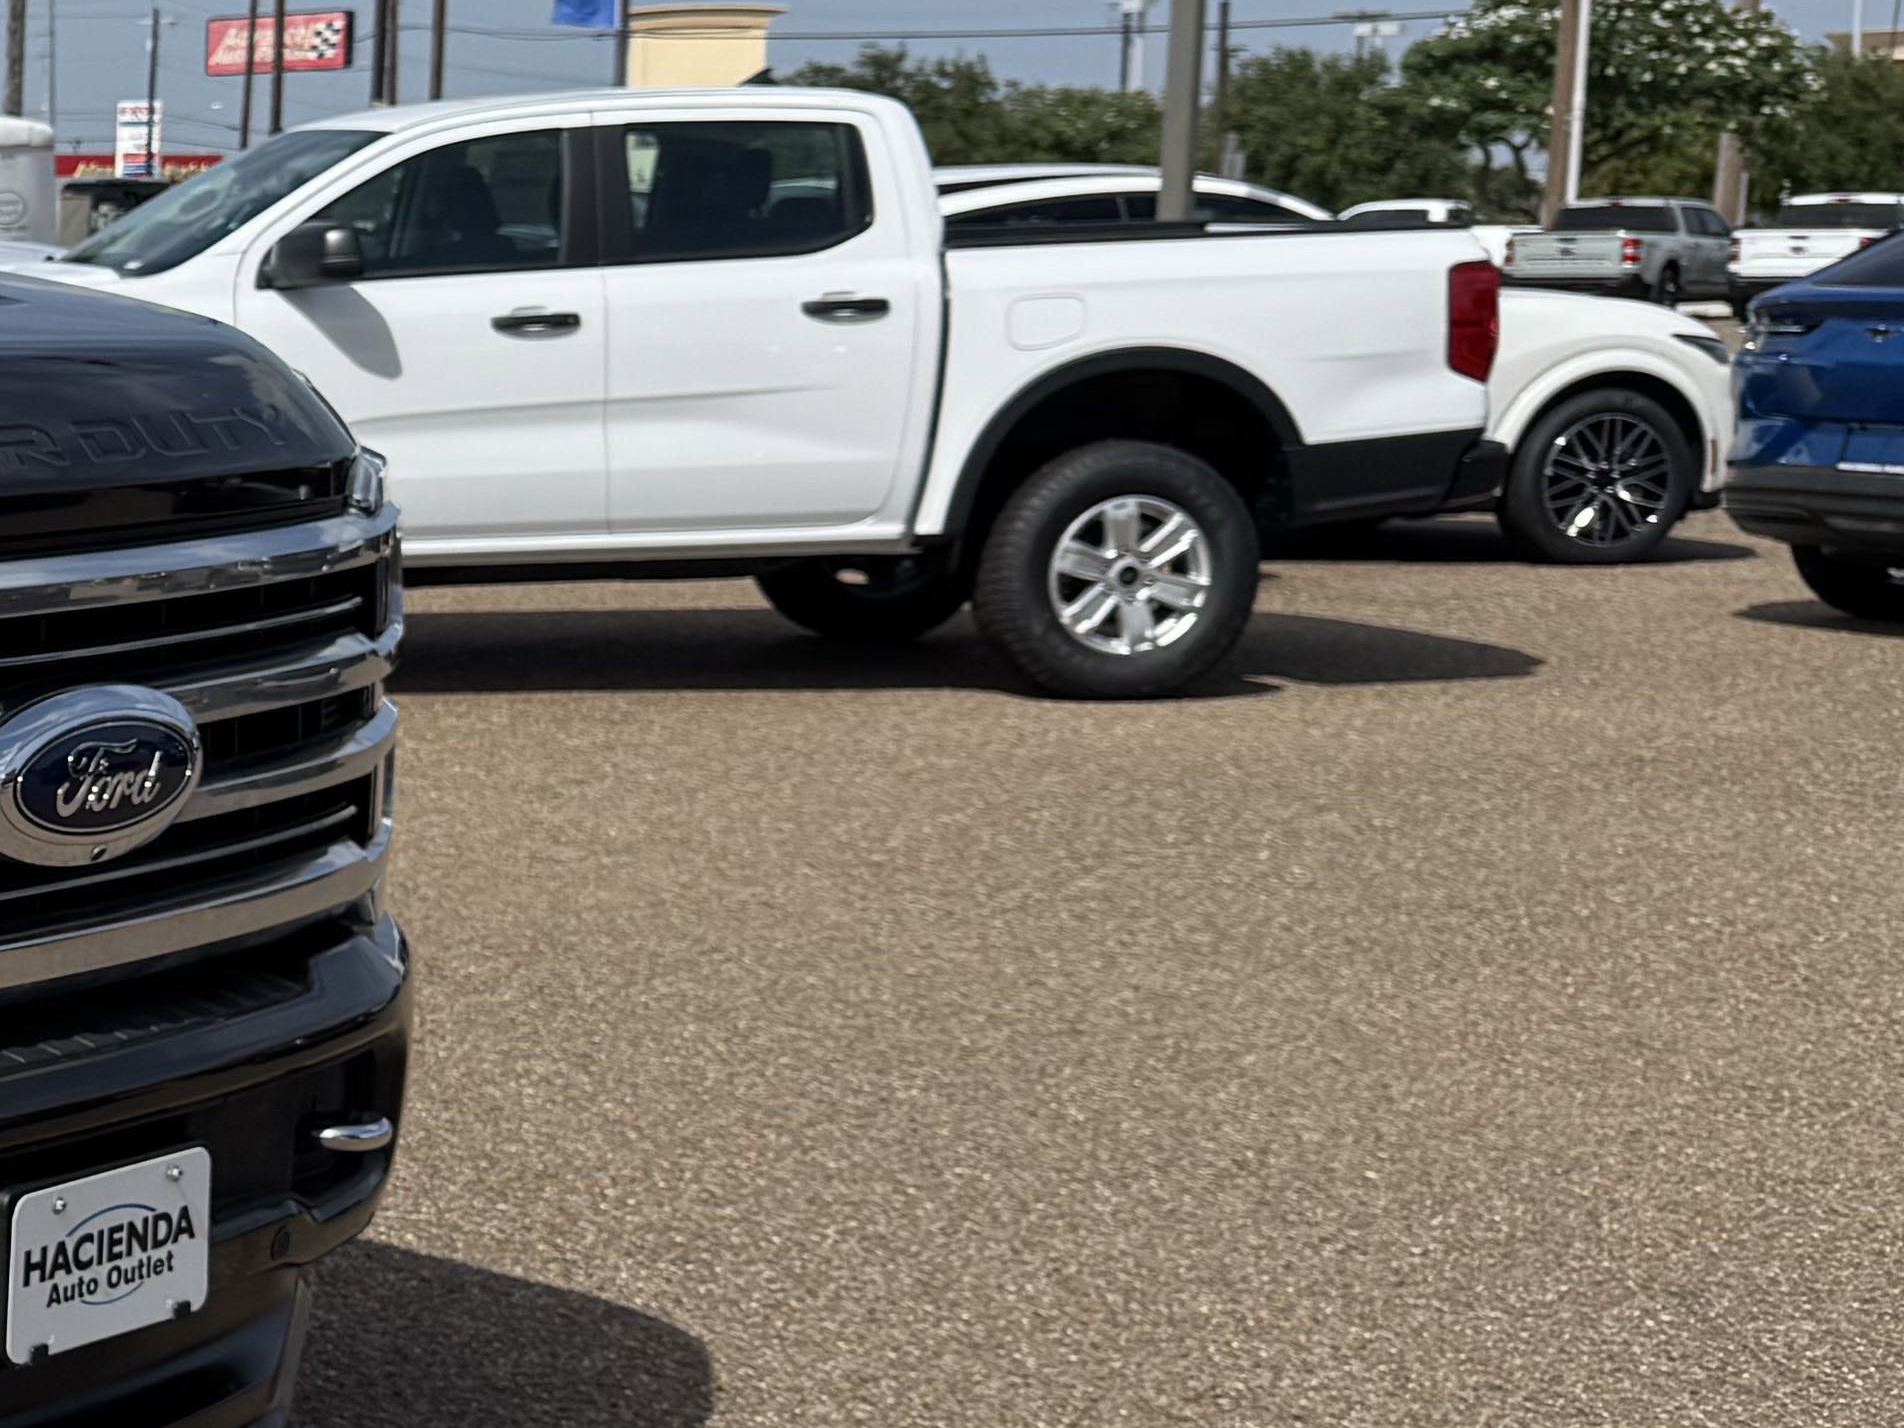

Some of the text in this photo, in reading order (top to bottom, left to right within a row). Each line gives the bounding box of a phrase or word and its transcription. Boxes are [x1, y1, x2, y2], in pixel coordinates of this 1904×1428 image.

[72, 403, 286, 462] DUTY
[56, 739, 162, 818] Ford
[23, 1205, 196, 1288] HACIENDA
[47, 1250, 174, 1309] Auto Outlet
